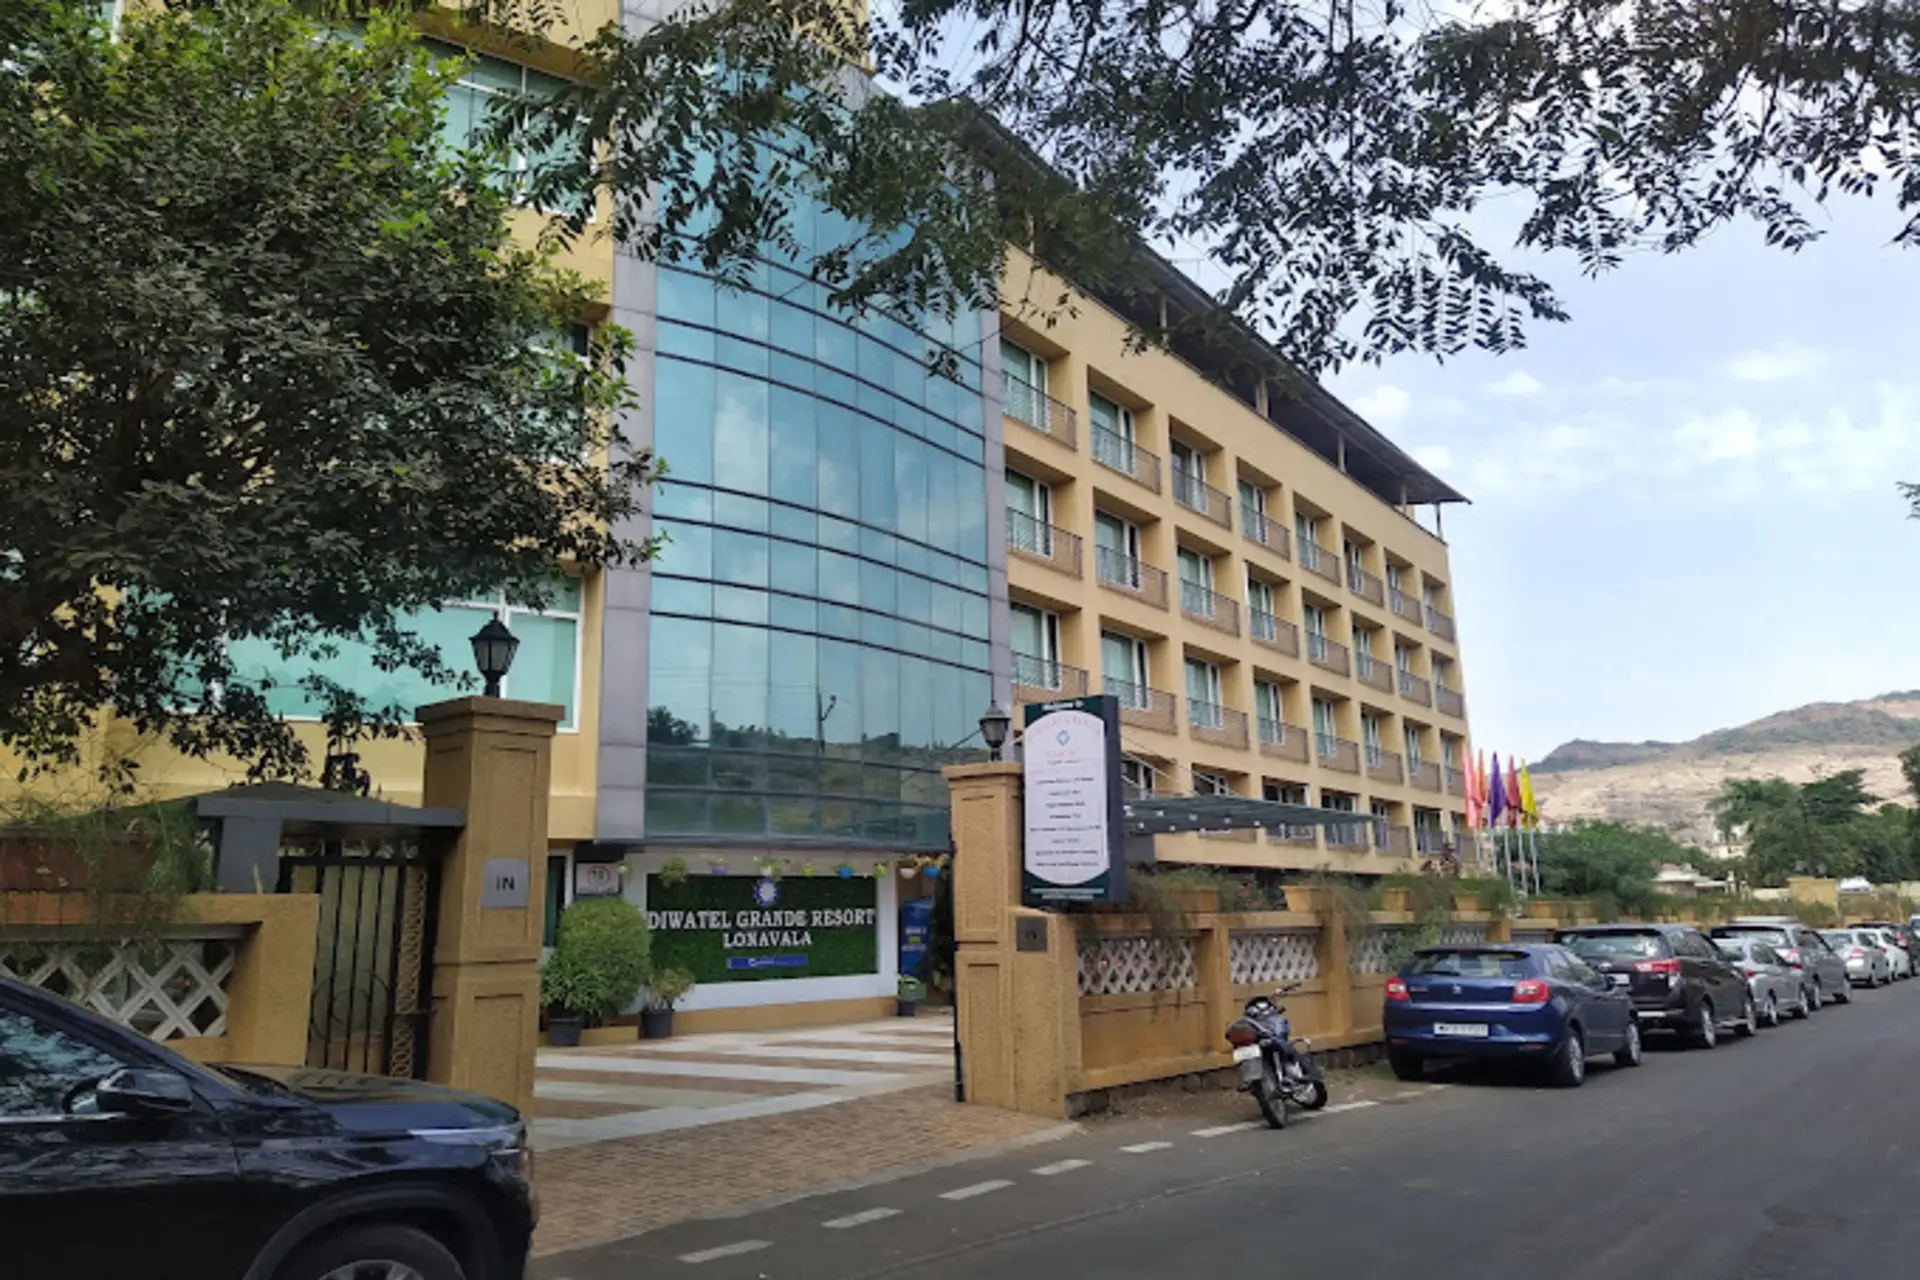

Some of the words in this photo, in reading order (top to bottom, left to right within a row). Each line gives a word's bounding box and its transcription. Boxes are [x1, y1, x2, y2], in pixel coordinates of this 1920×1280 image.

[496, 875, 515, 891] IN
[647, 910, 732, 930] DIWATEL
[736, 910, 807, 928] GRANDE
[810, 908, 876, 927] RESORT
[723, 930, 812, 949] LONAVALA
